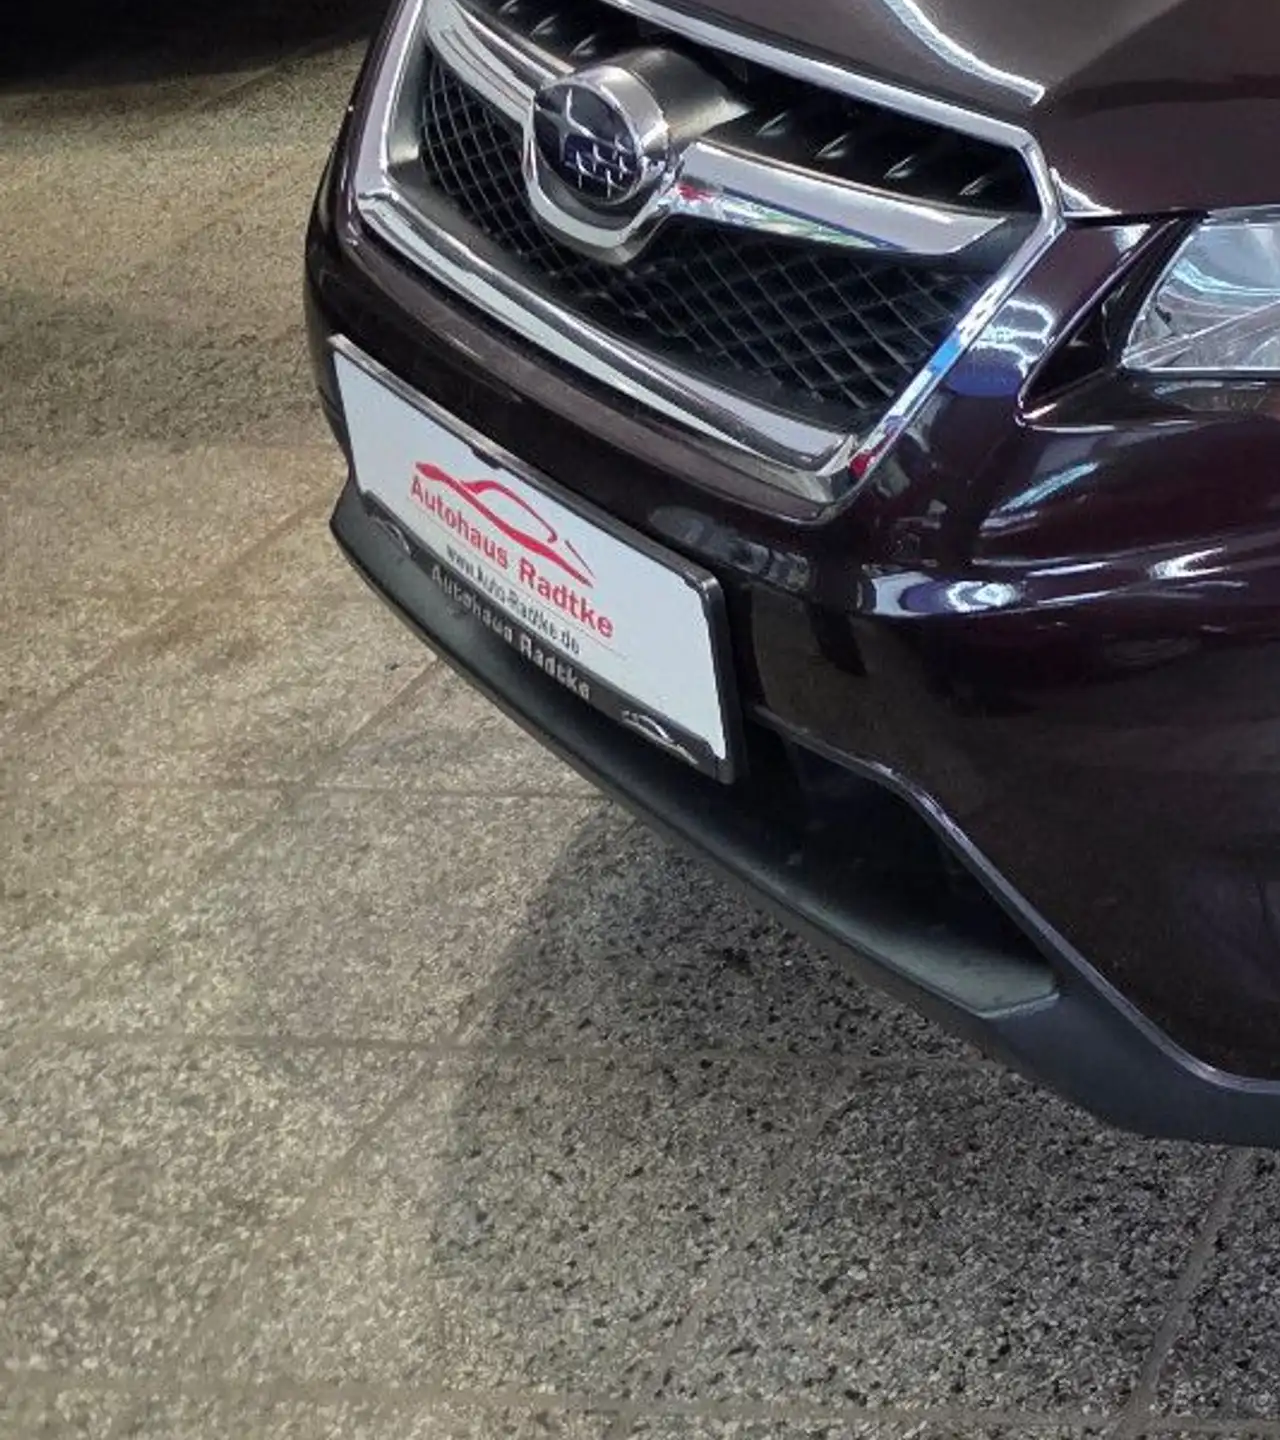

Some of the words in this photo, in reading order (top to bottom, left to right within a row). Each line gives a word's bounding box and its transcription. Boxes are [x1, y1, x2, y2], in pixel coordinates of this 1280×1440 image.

[410, 475, 509, 570] Autohaus
[518, 555, 615, 639] Radtke
[431, 563, 514, 644] Autohaus
[519, 631, 592, 702] Radtke
